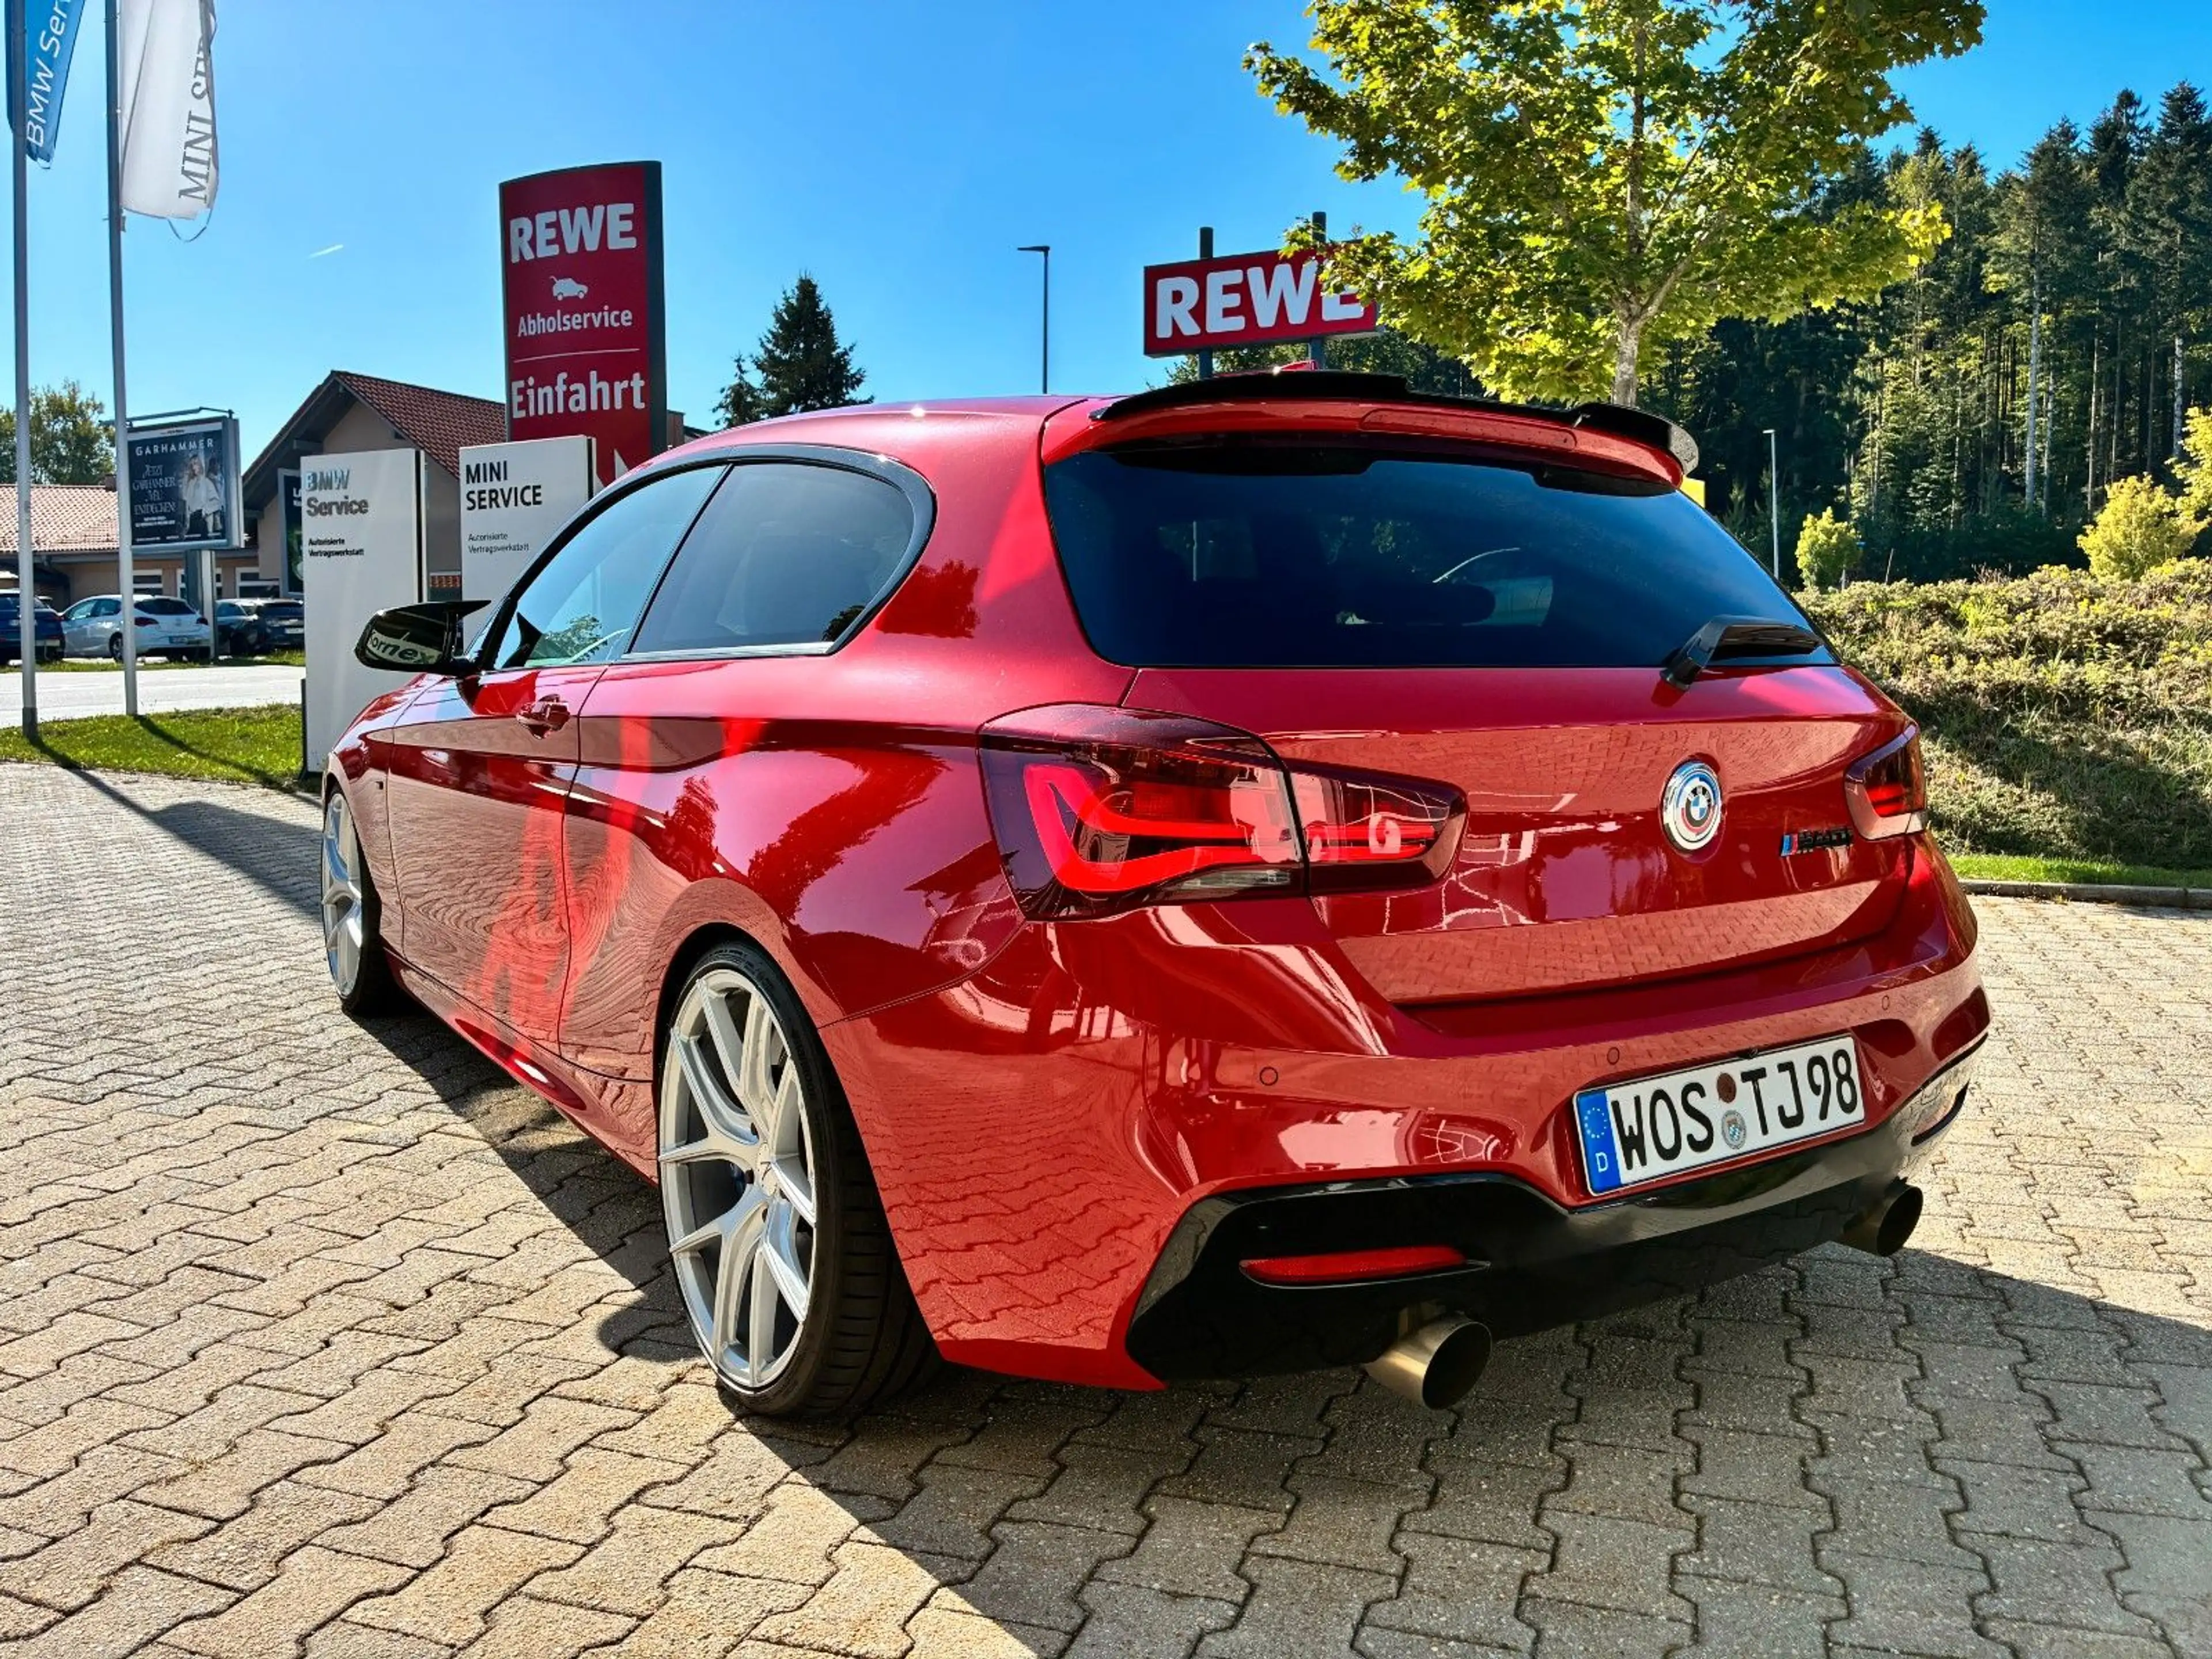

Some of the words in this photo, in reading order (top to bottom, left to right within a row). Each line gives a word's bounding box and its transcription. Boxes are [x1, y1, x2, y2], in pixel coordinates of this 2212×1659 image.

[39, 0, 70, 58] Ser
[26, 57, 55, 147] BMW
[179, 111, 212, 204] MINI
[510, 203, 637, 263] REWE
[518, 306, 632, 336] Abholservice
[512, 370, 645, 419] Einfahrt
[135, 438, 214, 456] GARHAMMER
[306, 469, 349, 491] BMW
[465, 461, 507, 484] MINI
[306, 495, 369, 517] Service
[465, 485, 542, 511] SERVICE
[308, 537, 344, 546] Autorisierte
[468, 533, 508, 541] Autorisierte
[468, 543, 529, 554] Vertragswerkstatt
[308, 548, 364, 558] Vertragswerkstatt
[1611, 1082, 1714, 1171] WOS
[1740, 1049, 1857, 1136] TJ98
[1596, 1152, 1608, 1173] D
